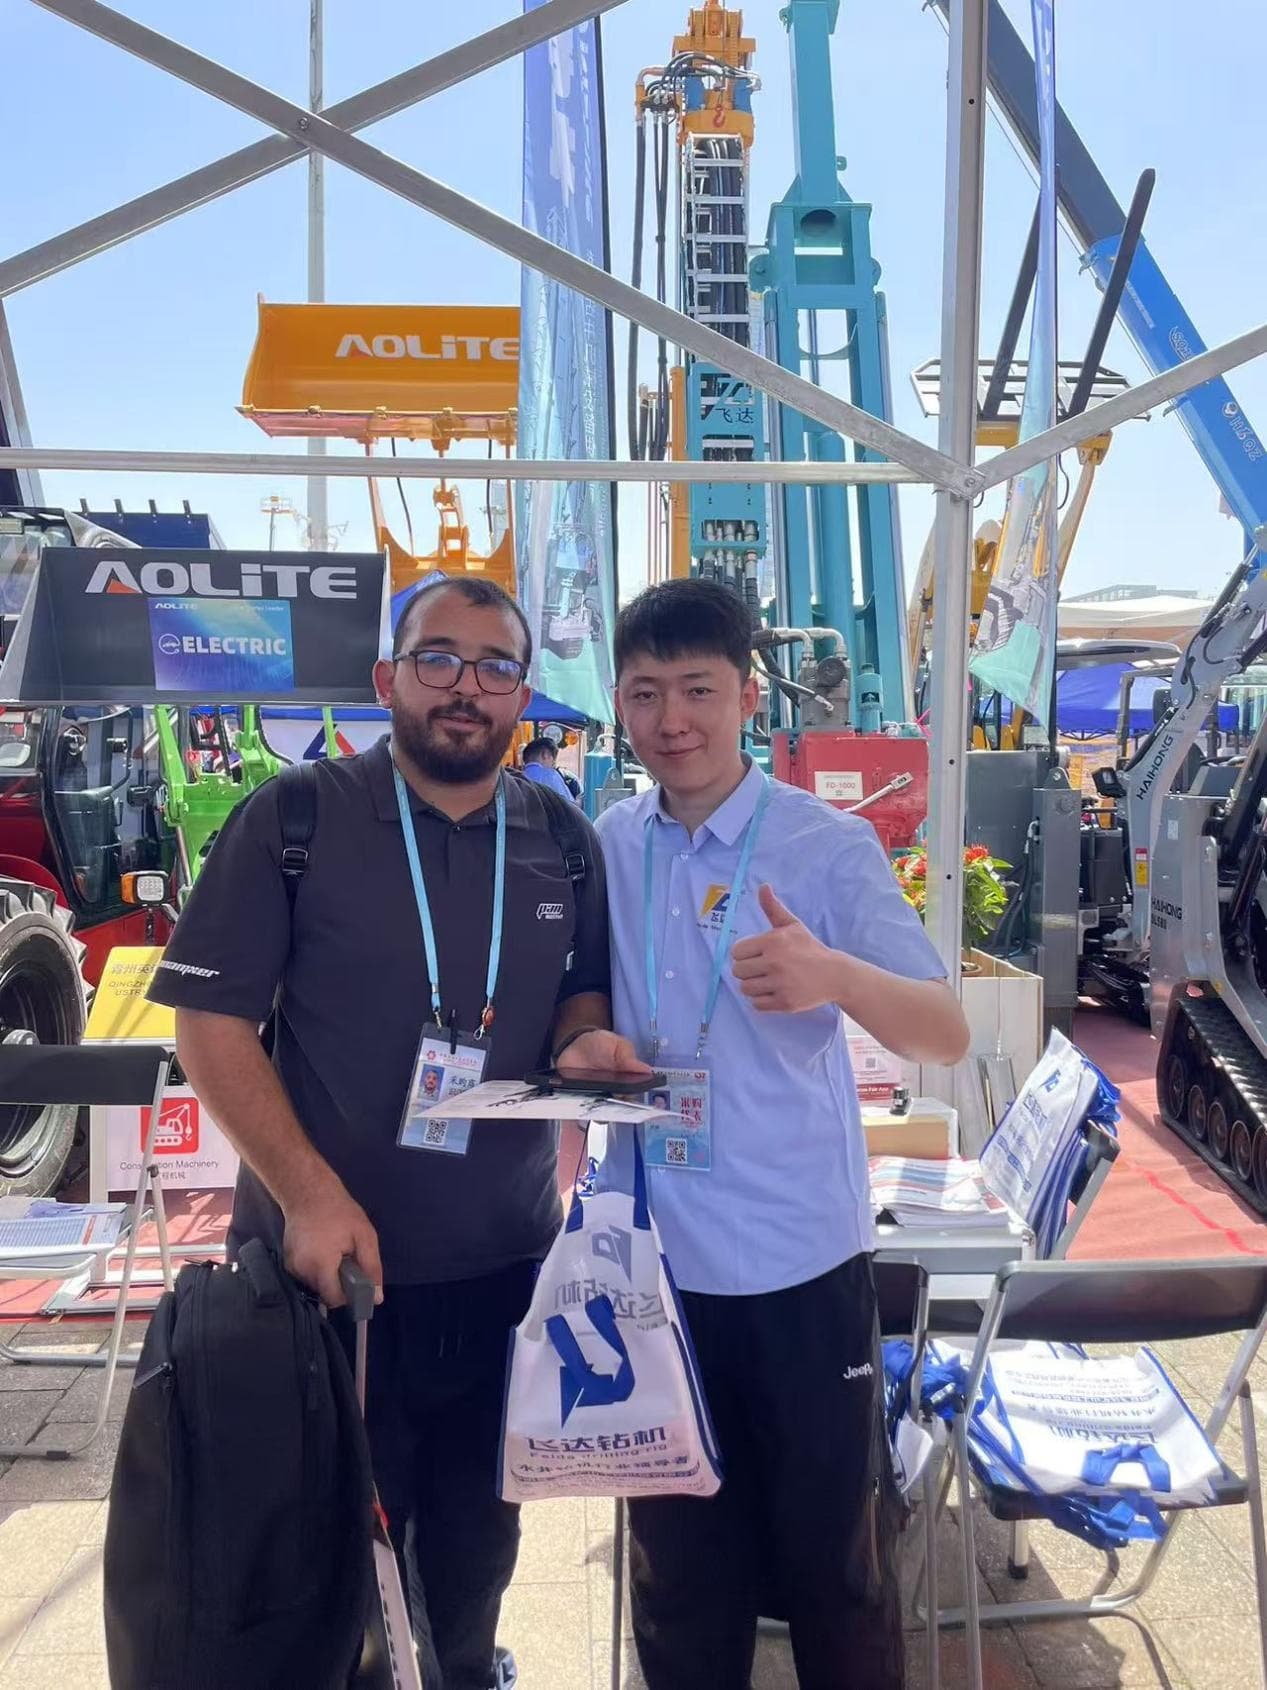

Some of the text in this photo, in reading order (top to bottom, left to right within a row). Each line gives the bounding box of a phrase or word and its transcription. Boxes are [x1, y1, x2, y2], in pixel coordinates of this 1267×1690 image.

[714, 407, 754, 423] 飞达
[182, 635, 287, 656] ELECTRIC
[1136, 734, 1174, 800] HAIHONG
[108, 980, 147, 988] QINGZH
[175, 1159, 219, 1169] Machinery
[843, 1362, 873, 1380] Jeep
[527, 1426, 667, 1453] 飞达钻机
